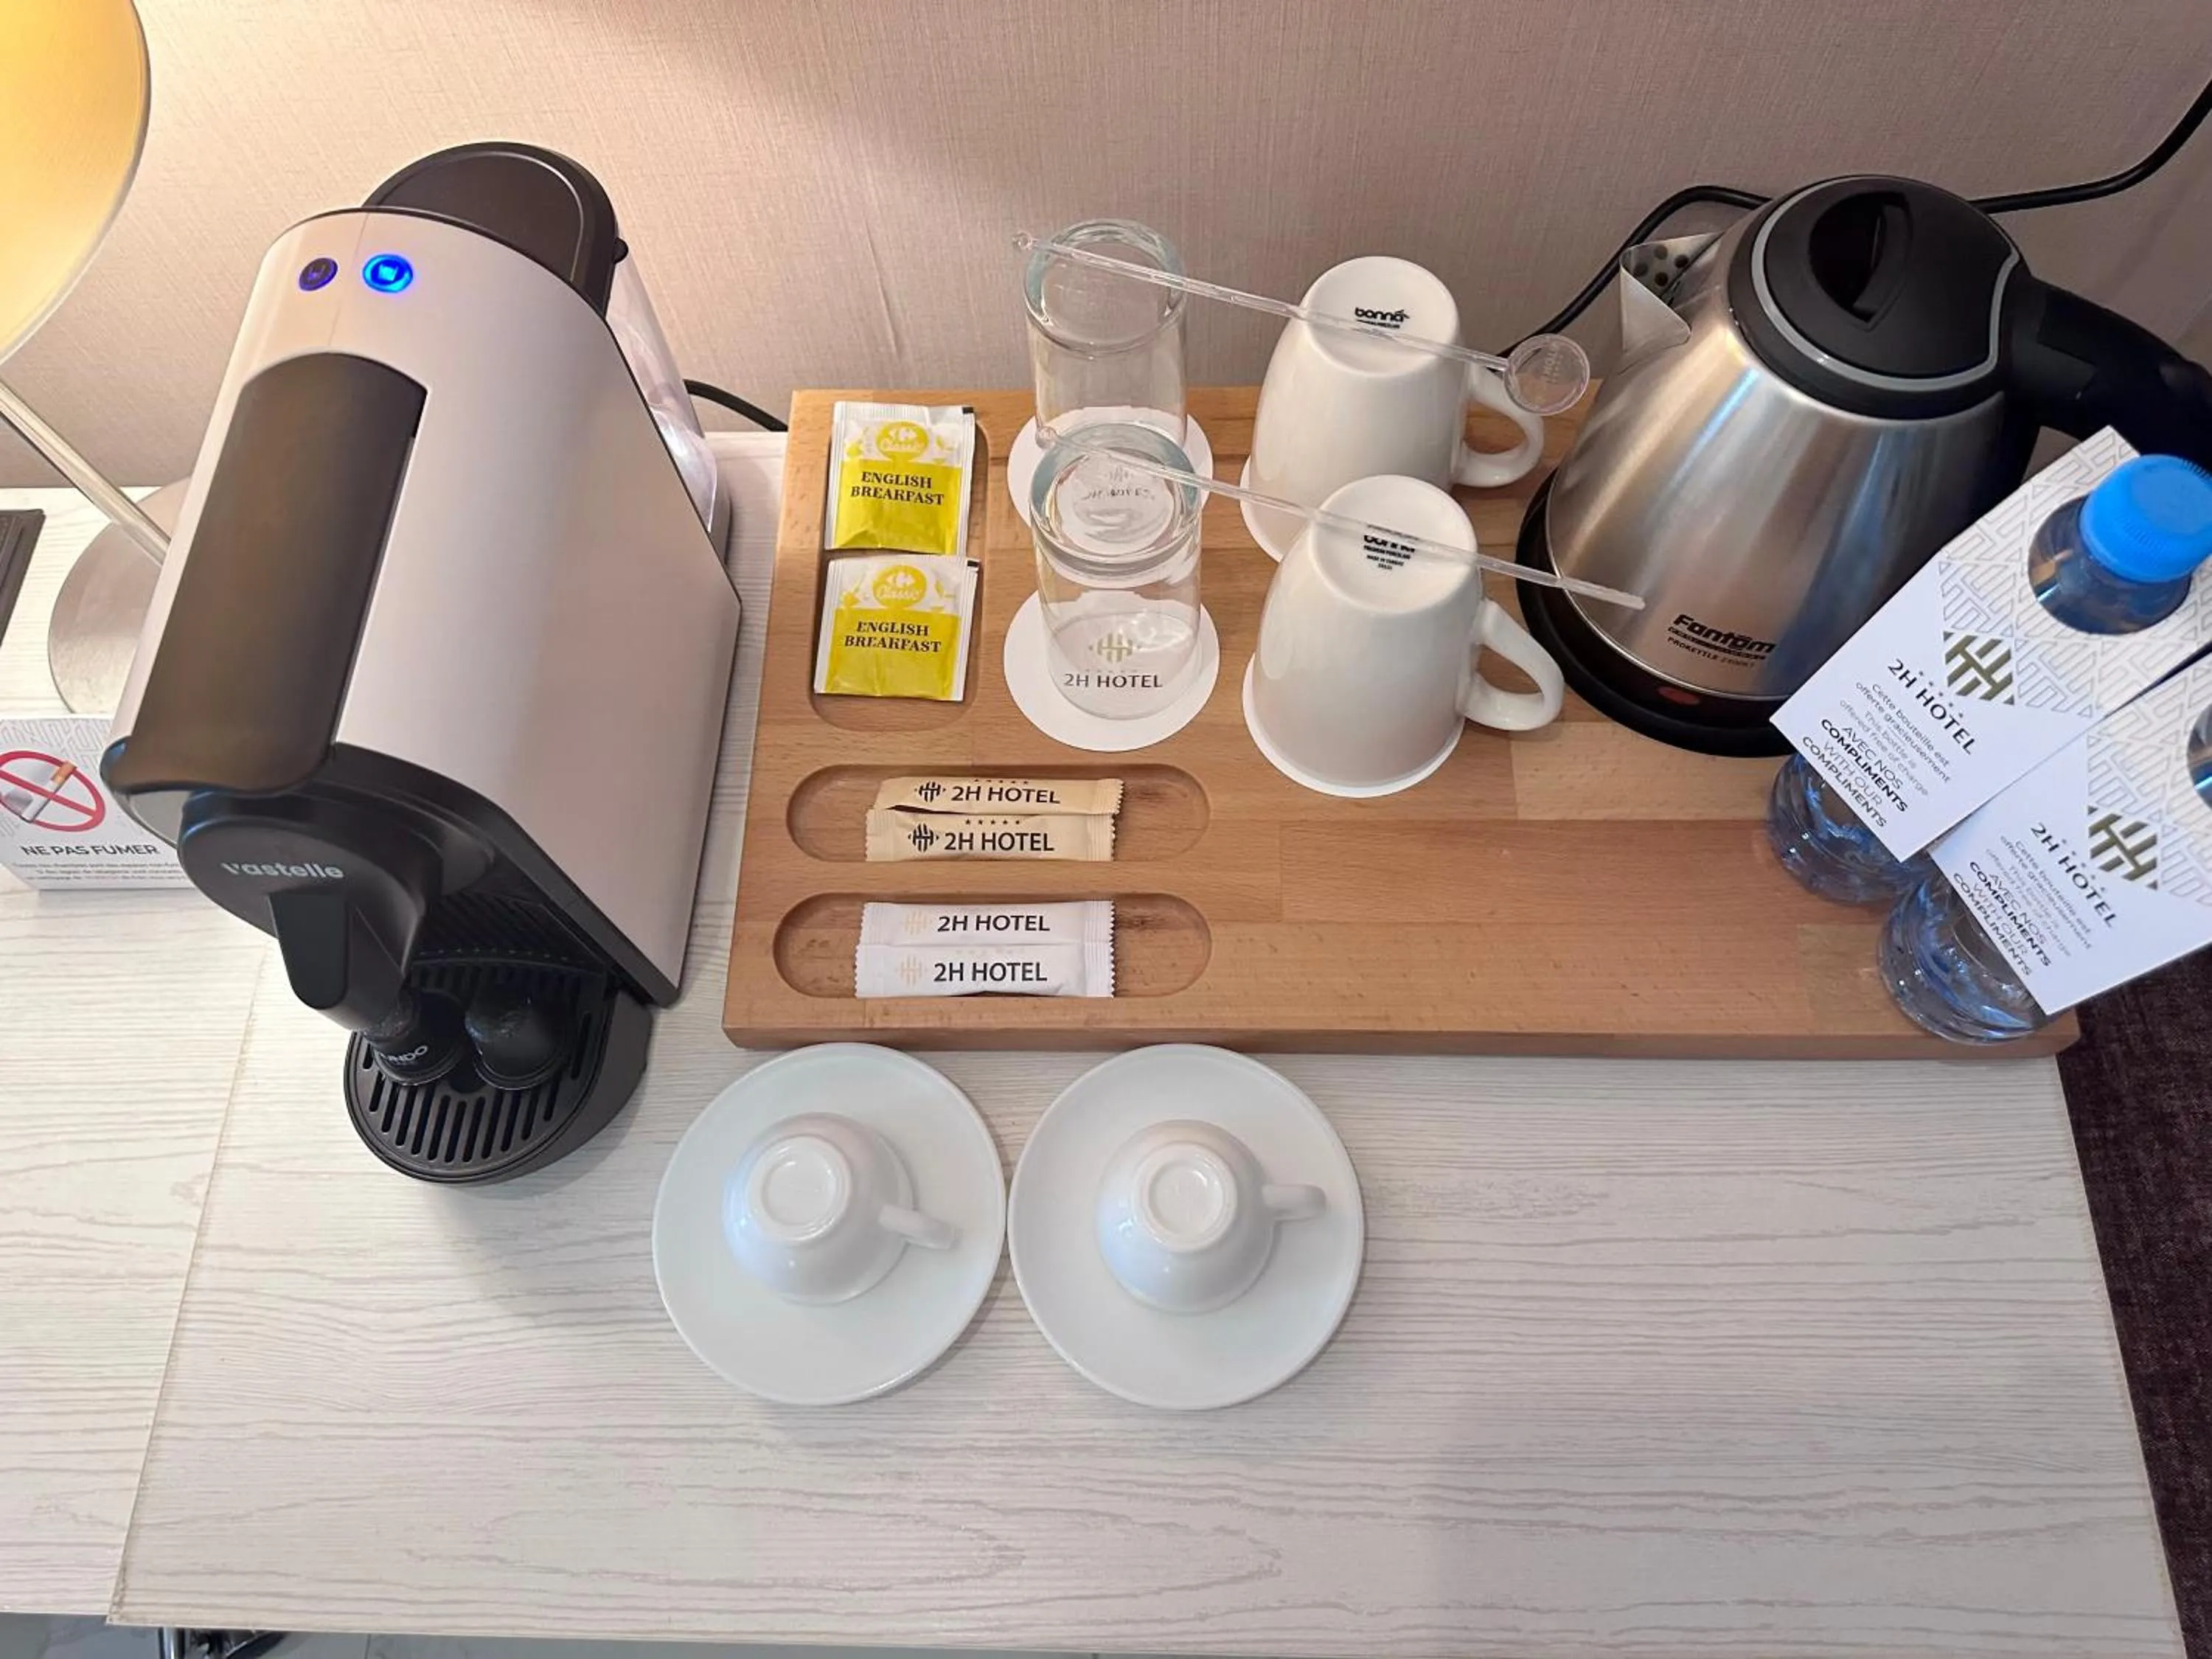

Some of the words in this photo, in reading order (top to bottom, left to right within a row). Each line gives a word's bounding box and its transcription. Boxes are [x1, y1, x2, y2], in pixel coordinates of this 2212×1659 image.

[861, 471, 932, 489] ENGLISH
[850, 487, 945, 506] BREAKFAST
[856, 621, 929, 636] ENGLISH
[844, 636, 942, 653] BREAKFAST
[1063, 673, 1090, 688] 2H
[1096, 674, 1163, 688] HOTEL
[1888, 659, 1917, 689] 2H
[1916, 689, 1975, 754] HOTEL
[1821, 720, 1907, 811] COMPLIMENTS
[1842, 728, 1877, 760] AVEC
[1874, 759, 1903, 790] NOS
[1803, 737, 1886, 827] COMPLIMENTS
[1823, 741, 1855, 776] WITH
[1854, 776, 1882, 807] OUR
[951, 786, 981, 802] 2H
[987, 787, 1061, 804] HOTEL
[21, 846, 50, 855] NE
[50, 846, 89, 855] PAS
[90, 844, 160, 855] FUMER
[944, 832, 974, 851] 2H
[981, 832, 1054, 852] HOTEL
[2031, 824, 2059, 852] 2H
[2059, 856, 2116, 927] HOTEL
[1970, 862, 2051, 966] COMPLIMENTS
[1989, 874, 2021, 910] AVEC
[2019, 912, 2047, 944] NOS
[937, 915, 968, 932] 2H
[975, 915, 1051, 931] HOTEL
[1953, 873, 2031, 975] COMPLIMENTS
[933, 962, 964, 982] 2H
[972, 962, 1048, 981] HOTEL
